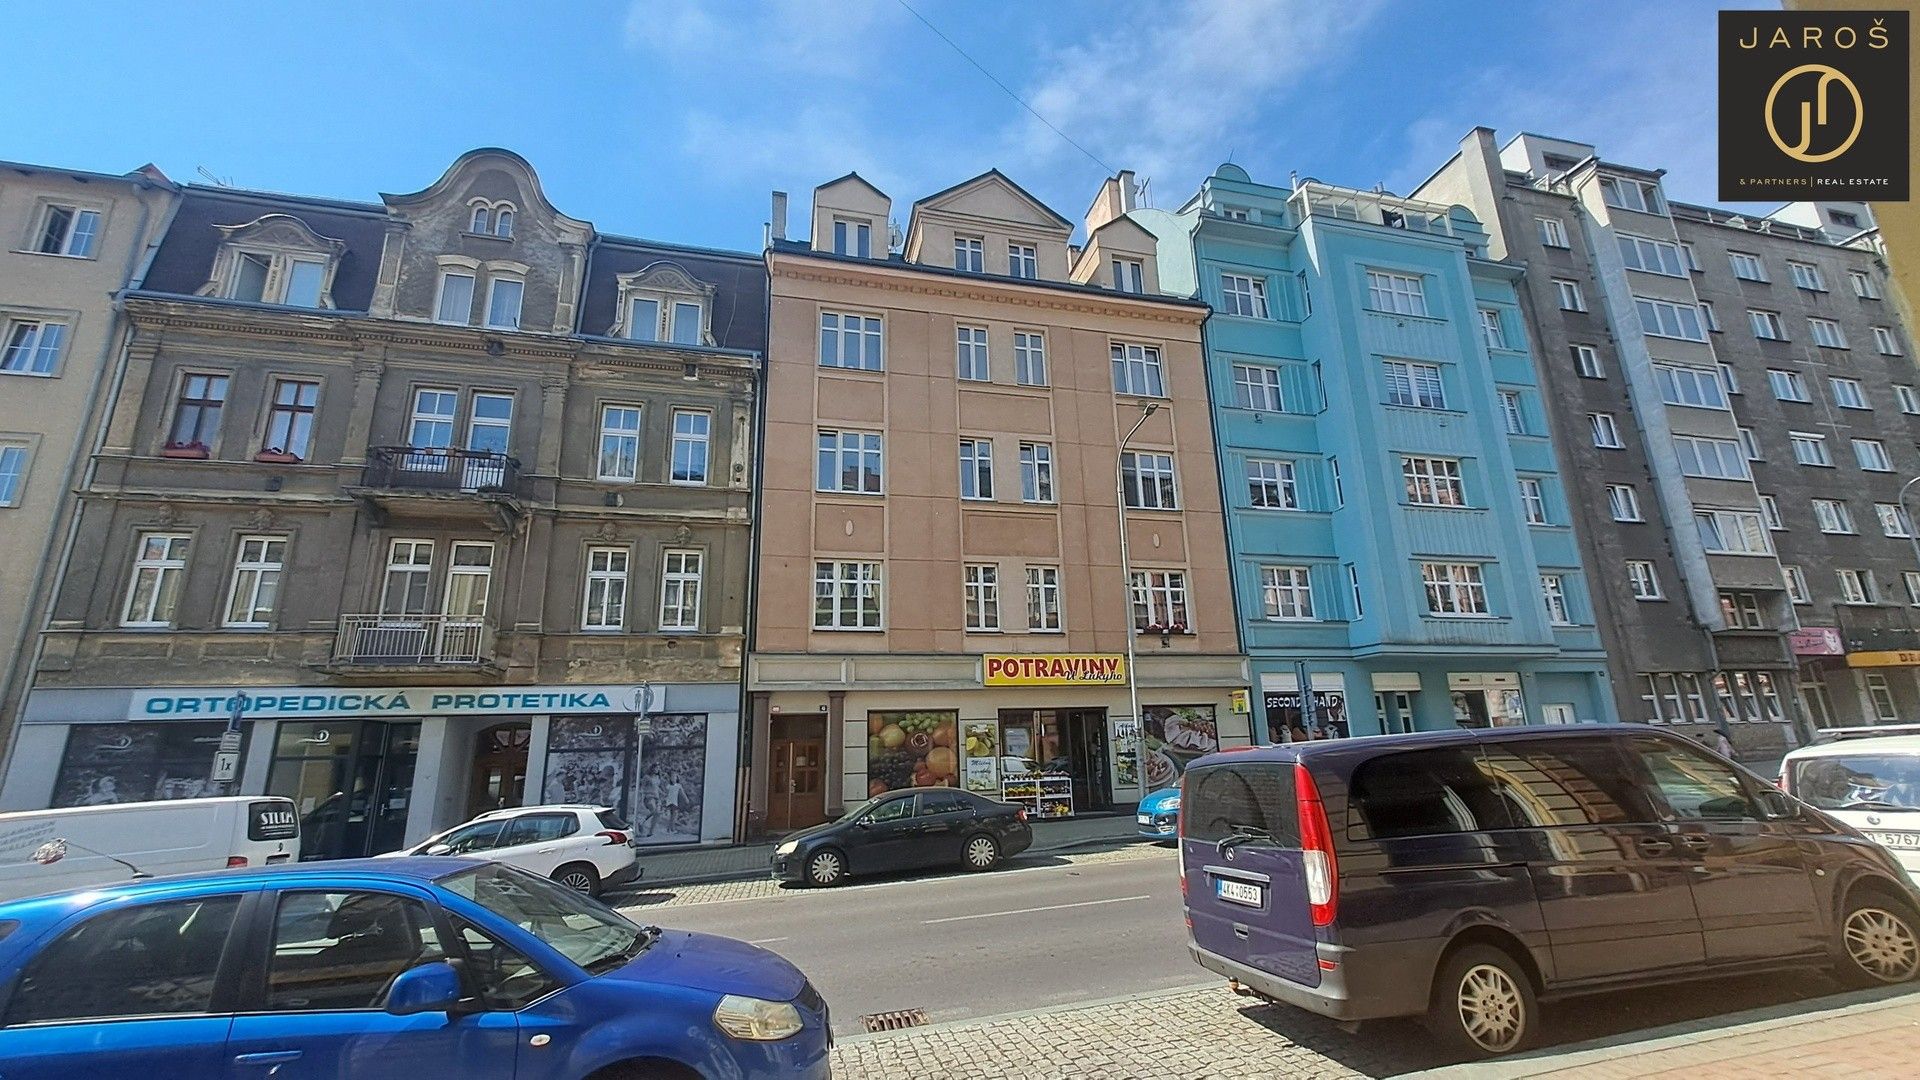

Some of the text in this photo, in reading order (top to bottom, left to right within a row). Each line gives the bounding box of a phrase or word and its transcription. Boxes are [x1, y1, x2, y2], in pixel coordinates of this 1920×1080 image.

[987, 657, 1119, 678] POTRAVINY
[1079, 671, 1122, 683] Lukyho
[145, 691, 610, 714] ORTOPEDICKÁ PROTETIKA
[1266, 696, 1338, 708] SECOND HAND
[220, 757, 232, 771] 1x
[1239, 886, 1258, 901] 0553
